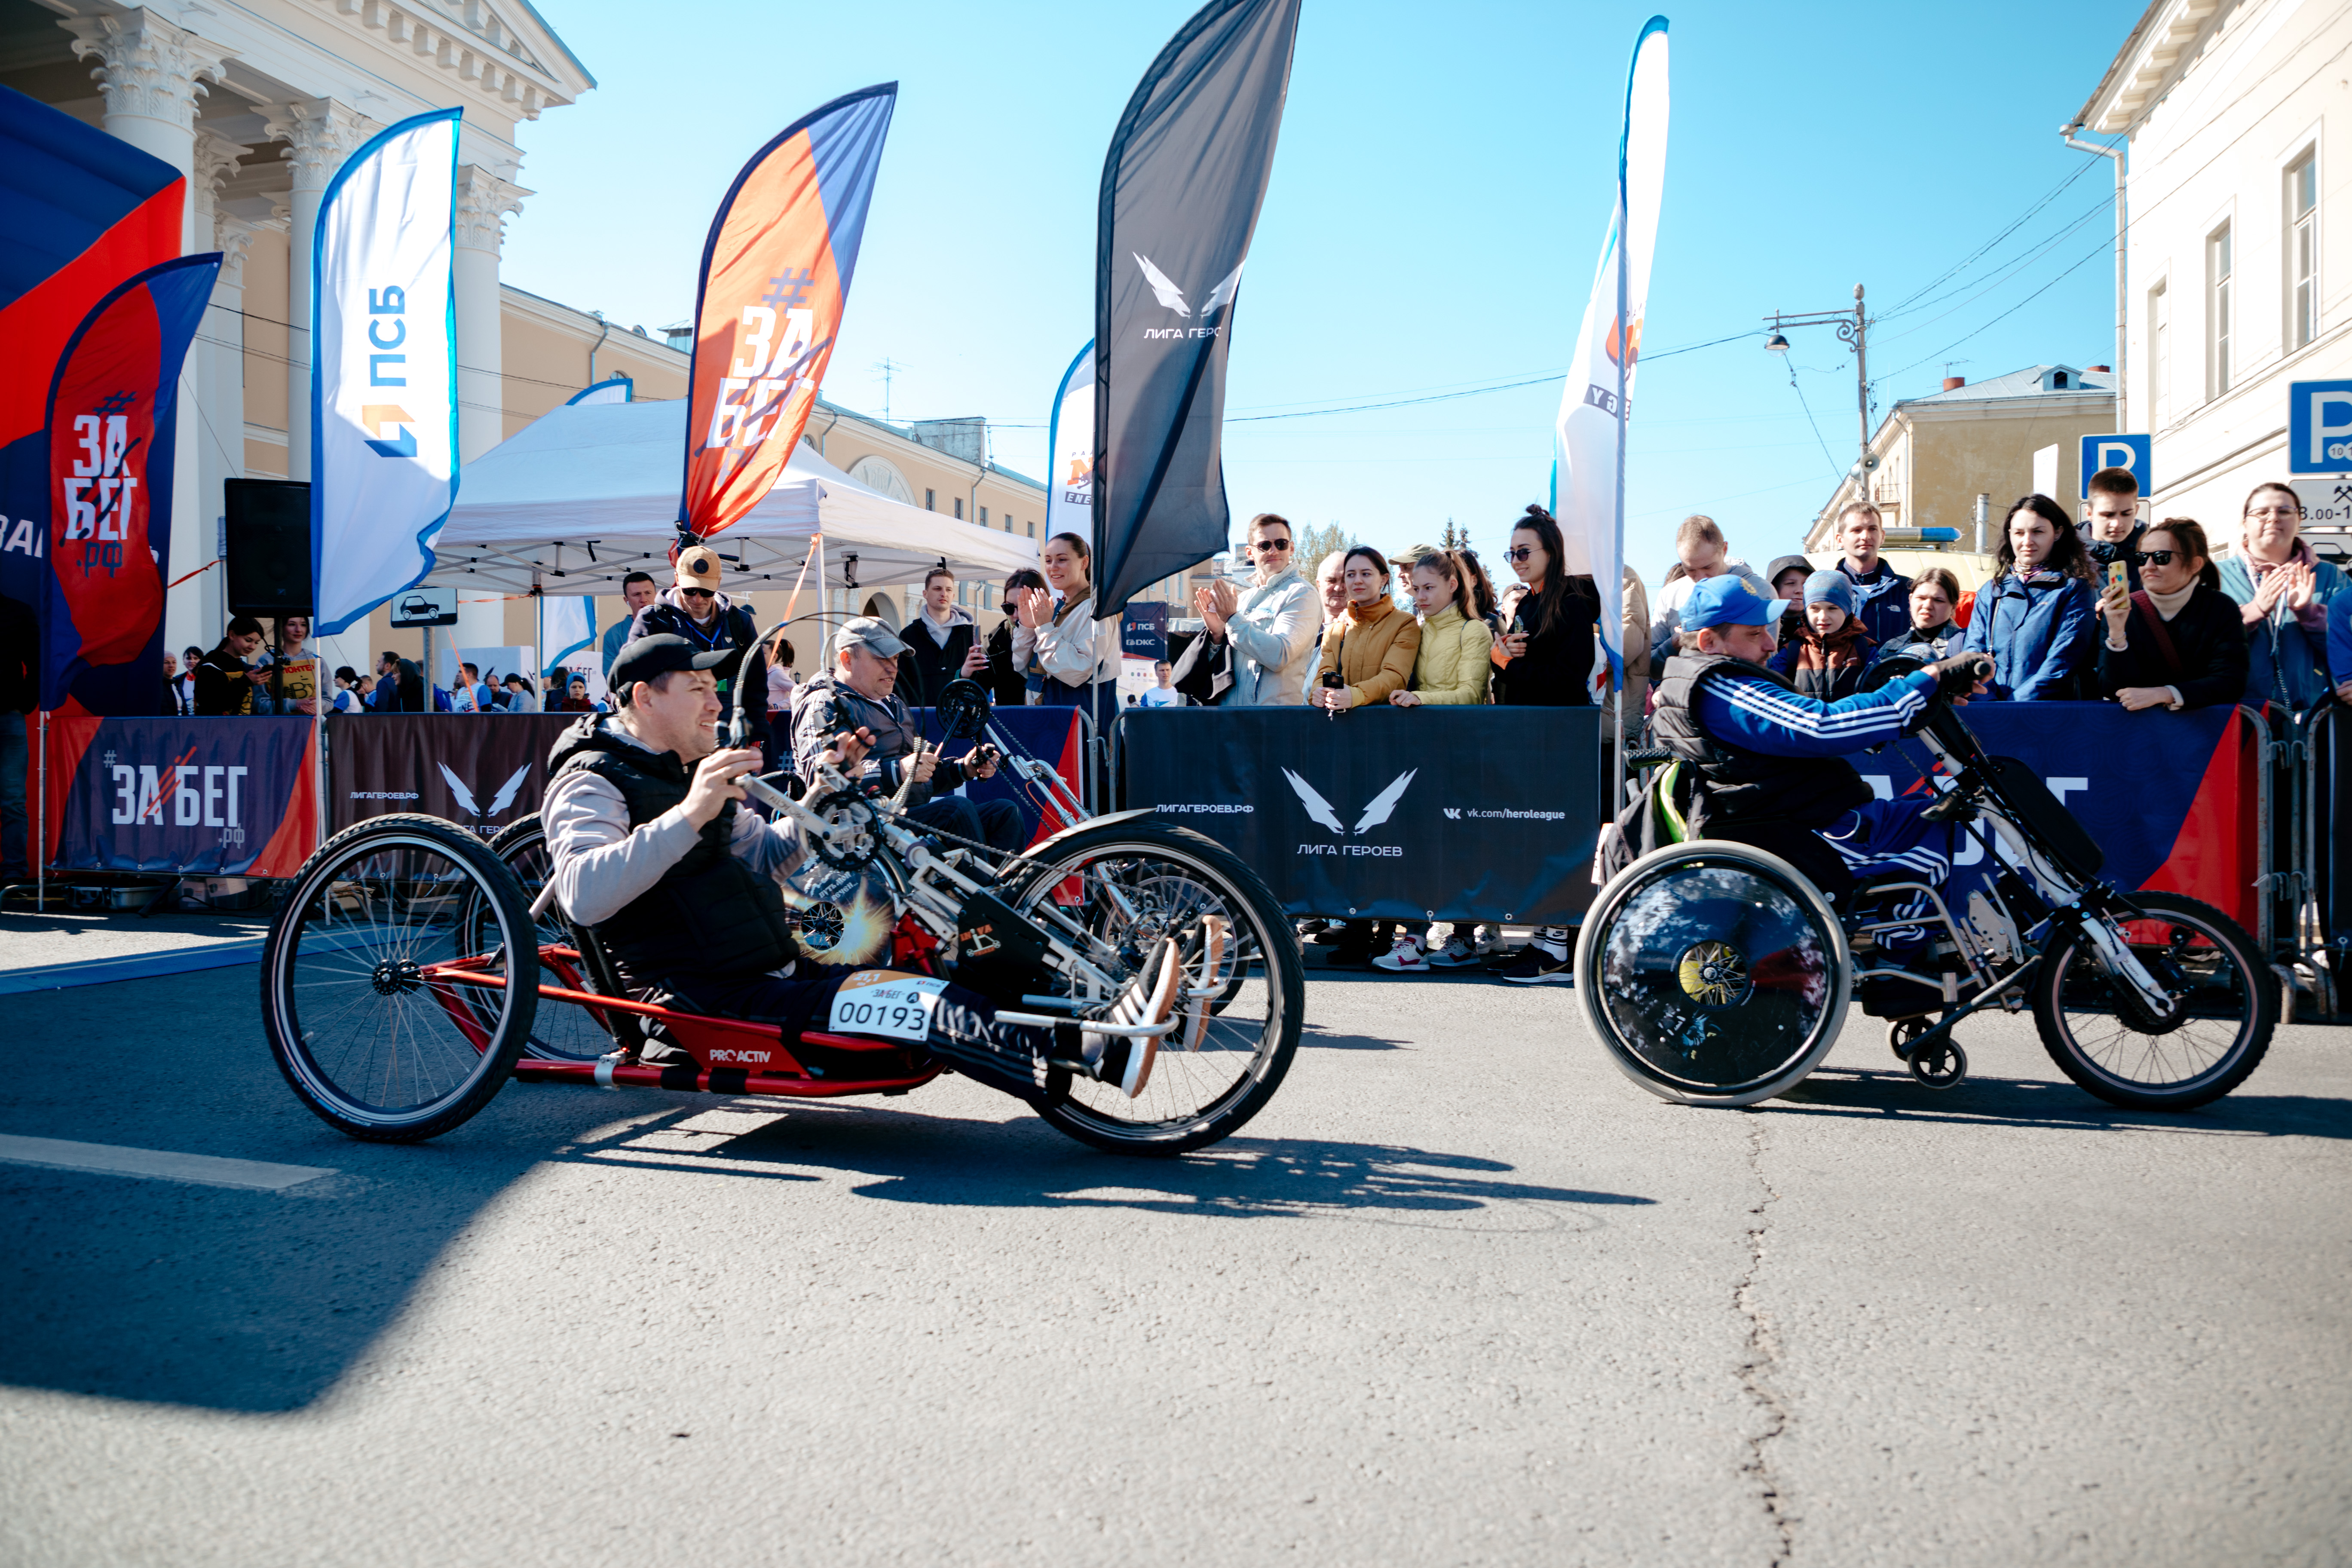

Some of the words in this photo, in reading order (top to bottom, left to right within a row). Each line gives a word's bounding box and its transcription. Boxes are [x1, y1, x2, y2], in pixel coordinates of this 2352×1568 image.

[368, 285, 406, 387] ПСБ
[1144, 328, 1183, 339] ЛИГА
[733, 306, 813, 378] ЗА
[74, 415, 130, 477] ЗА
[2331, 447, 2343, 456] 10
[1067, 493, 1091, 504] ENE
[64, 478, 137, 540] БЕГ
[2300, 505, 2351, 520] 8.00-1
[1155, 804, 1254, 813] ЛИГАГЕРОЕВ.РФ
[1467, 808, 1565, 821] vk.com/heroleague
[1297, 844, 1337, 855] ЛИГА
[1343, 845, 1403, 856] ГЕРОЕВ
[853, 973, 880, 983] 21,1
[839, 1002, 925, 1030] 00193
